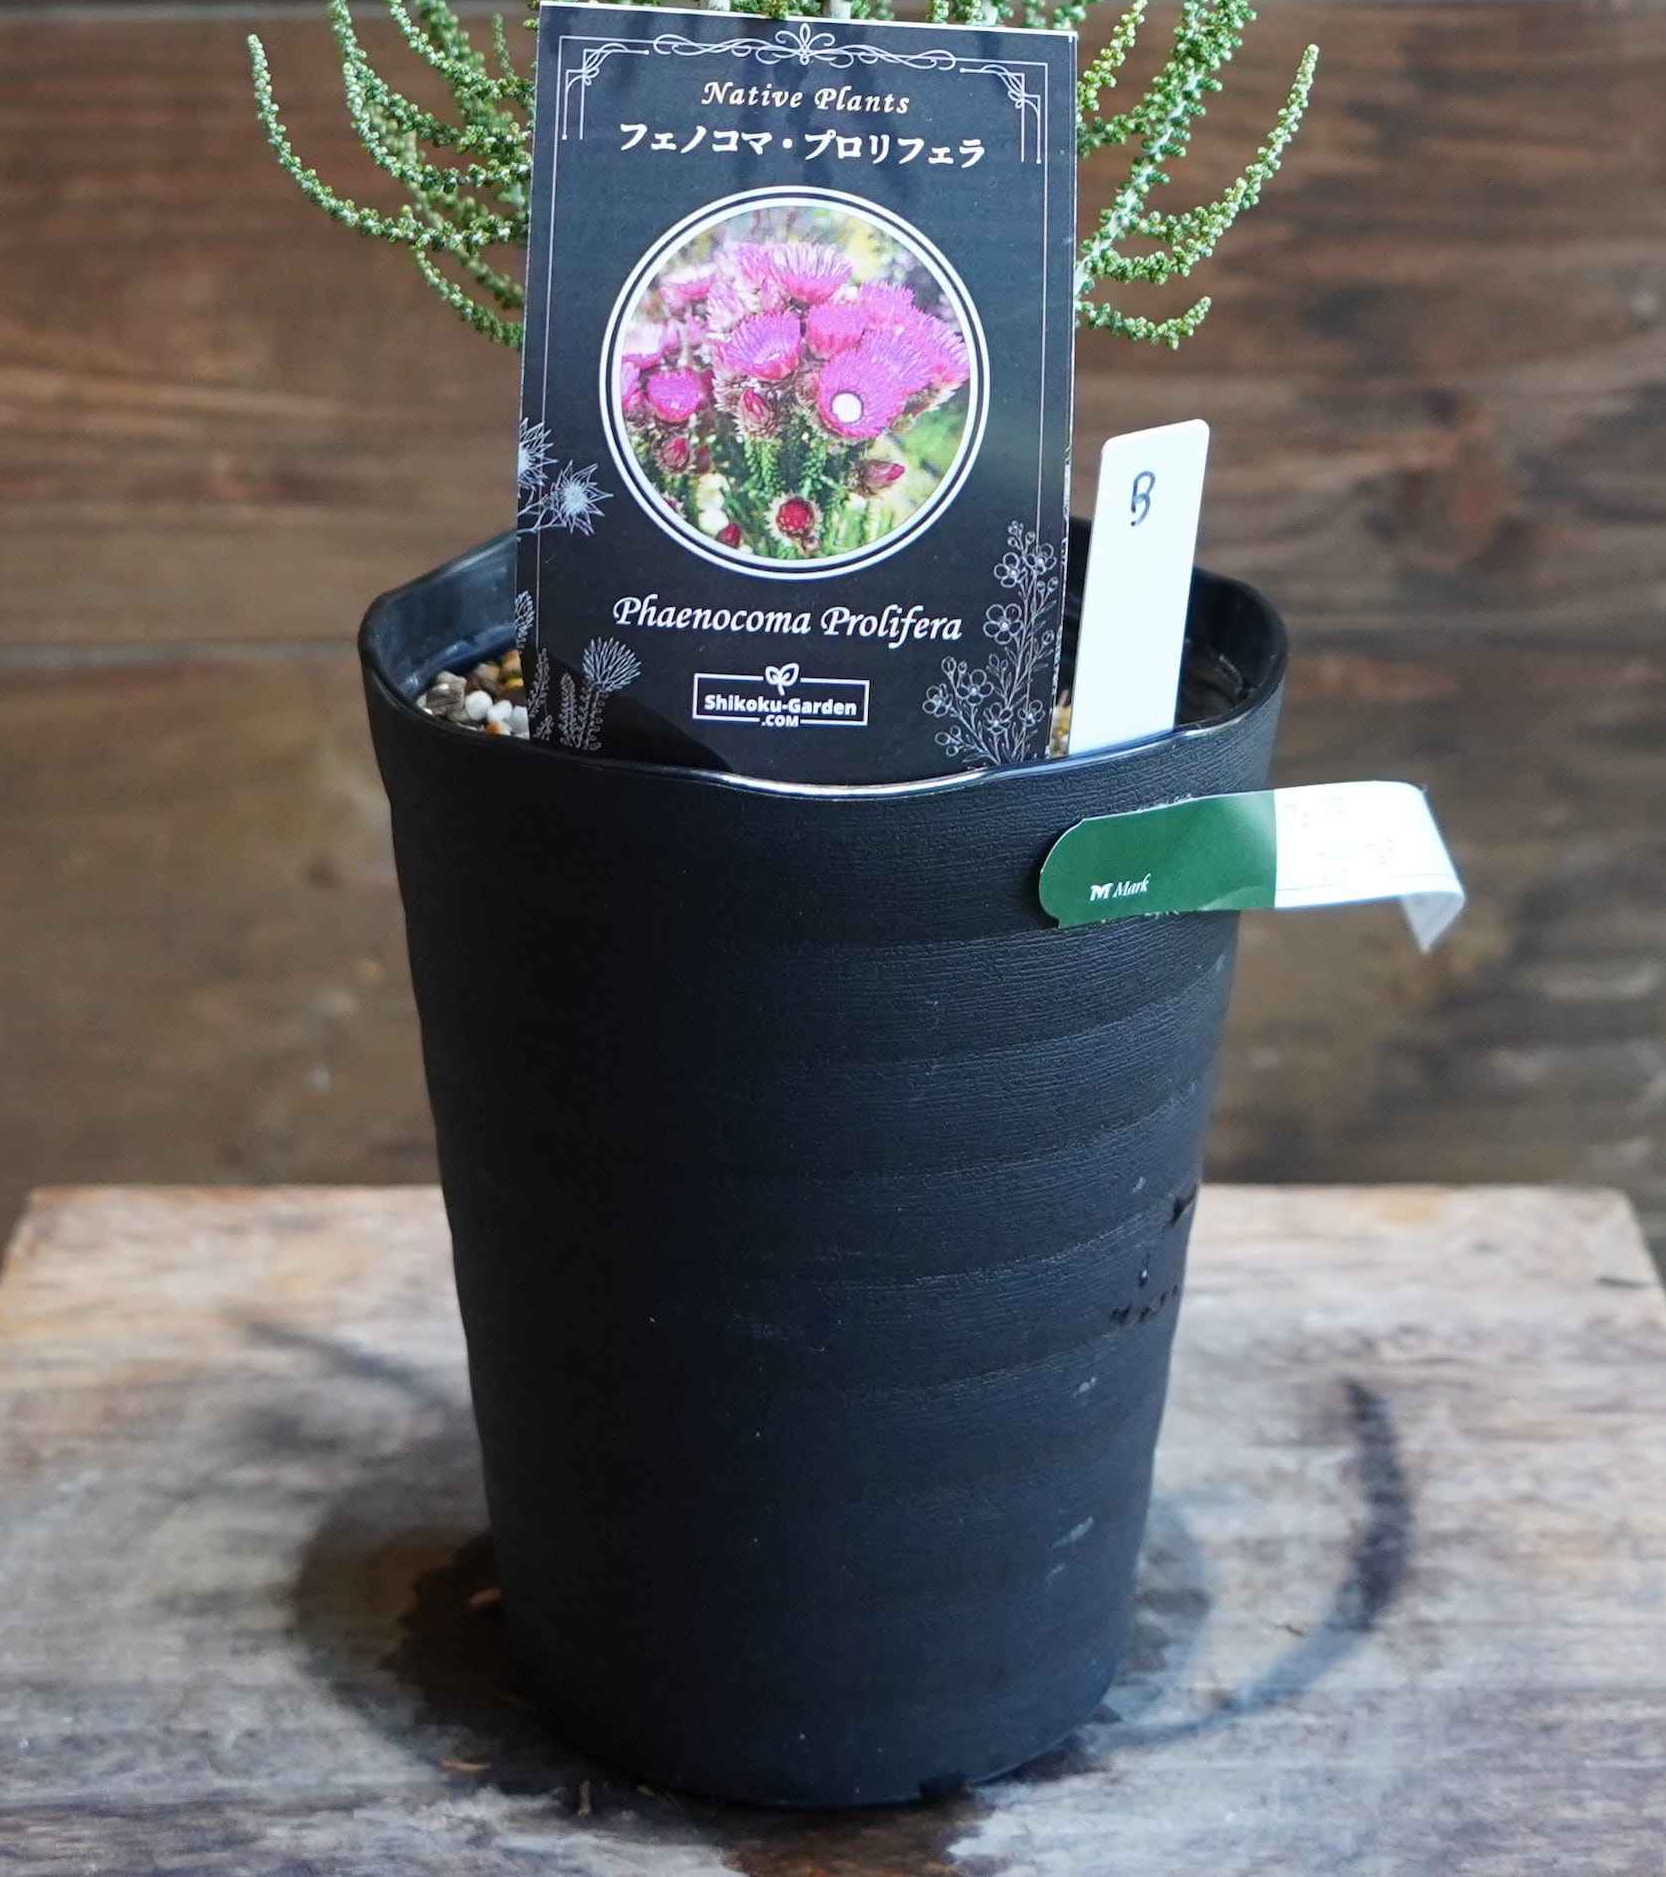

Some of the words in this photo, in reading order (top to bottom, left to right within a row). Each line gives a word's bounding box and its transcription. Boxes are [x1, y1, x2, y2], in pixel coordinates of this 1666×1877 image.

[699, 80, 804, 109] Native
[813, 84, 911, 115] Plants
[619, 122, 987, 169] フェノコマ・プロリフェラ
[611, 593, 812, 636] Phaenocoma
[819, 603, 964, 650] Prolifera
[702, 693, 859, 717] Shikoku-Garden
[760, 712, 801, 729] .COM
[1112, 873, 1152, 899] Mark
